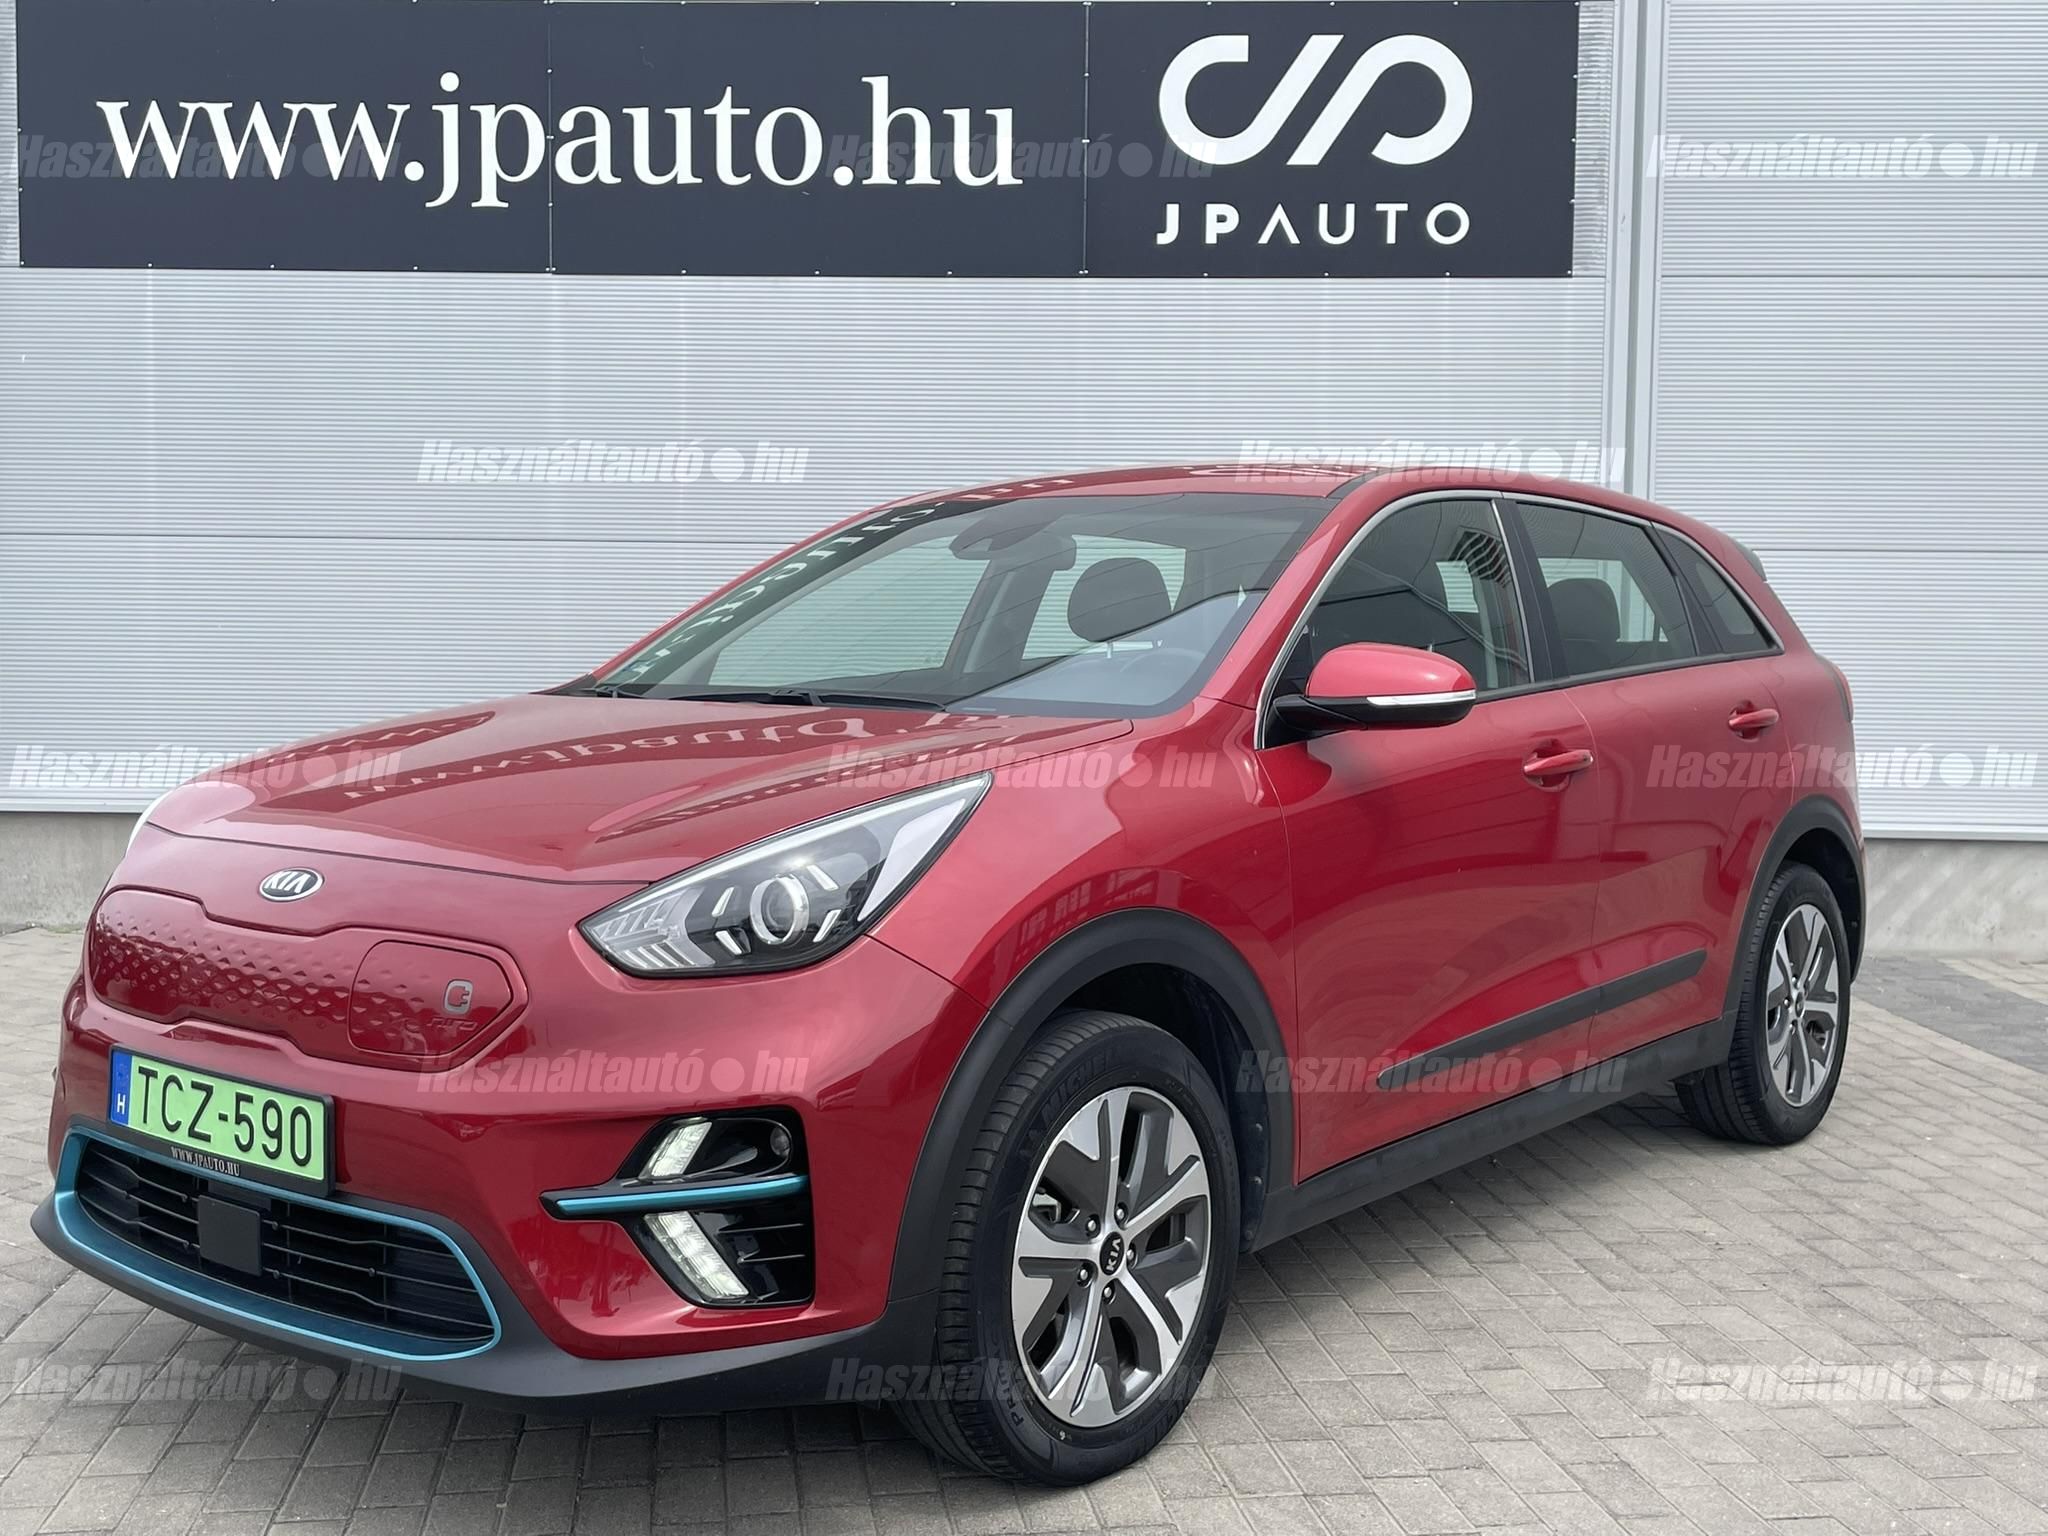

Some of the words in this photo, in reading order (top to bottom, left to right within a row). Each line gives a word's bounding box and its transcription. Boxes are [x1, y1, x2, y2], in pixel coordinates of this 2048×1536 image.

[97, 71, 1023, 209] www.jpauto.hu
[116, 1092, 126, 1115] H
[137, 1065, 313, 1168] TCZ-590
[170, 1146, 241, 1177] WWW.JPAUTO.HU
[1104, 1237, 1122, 1272] KIA
